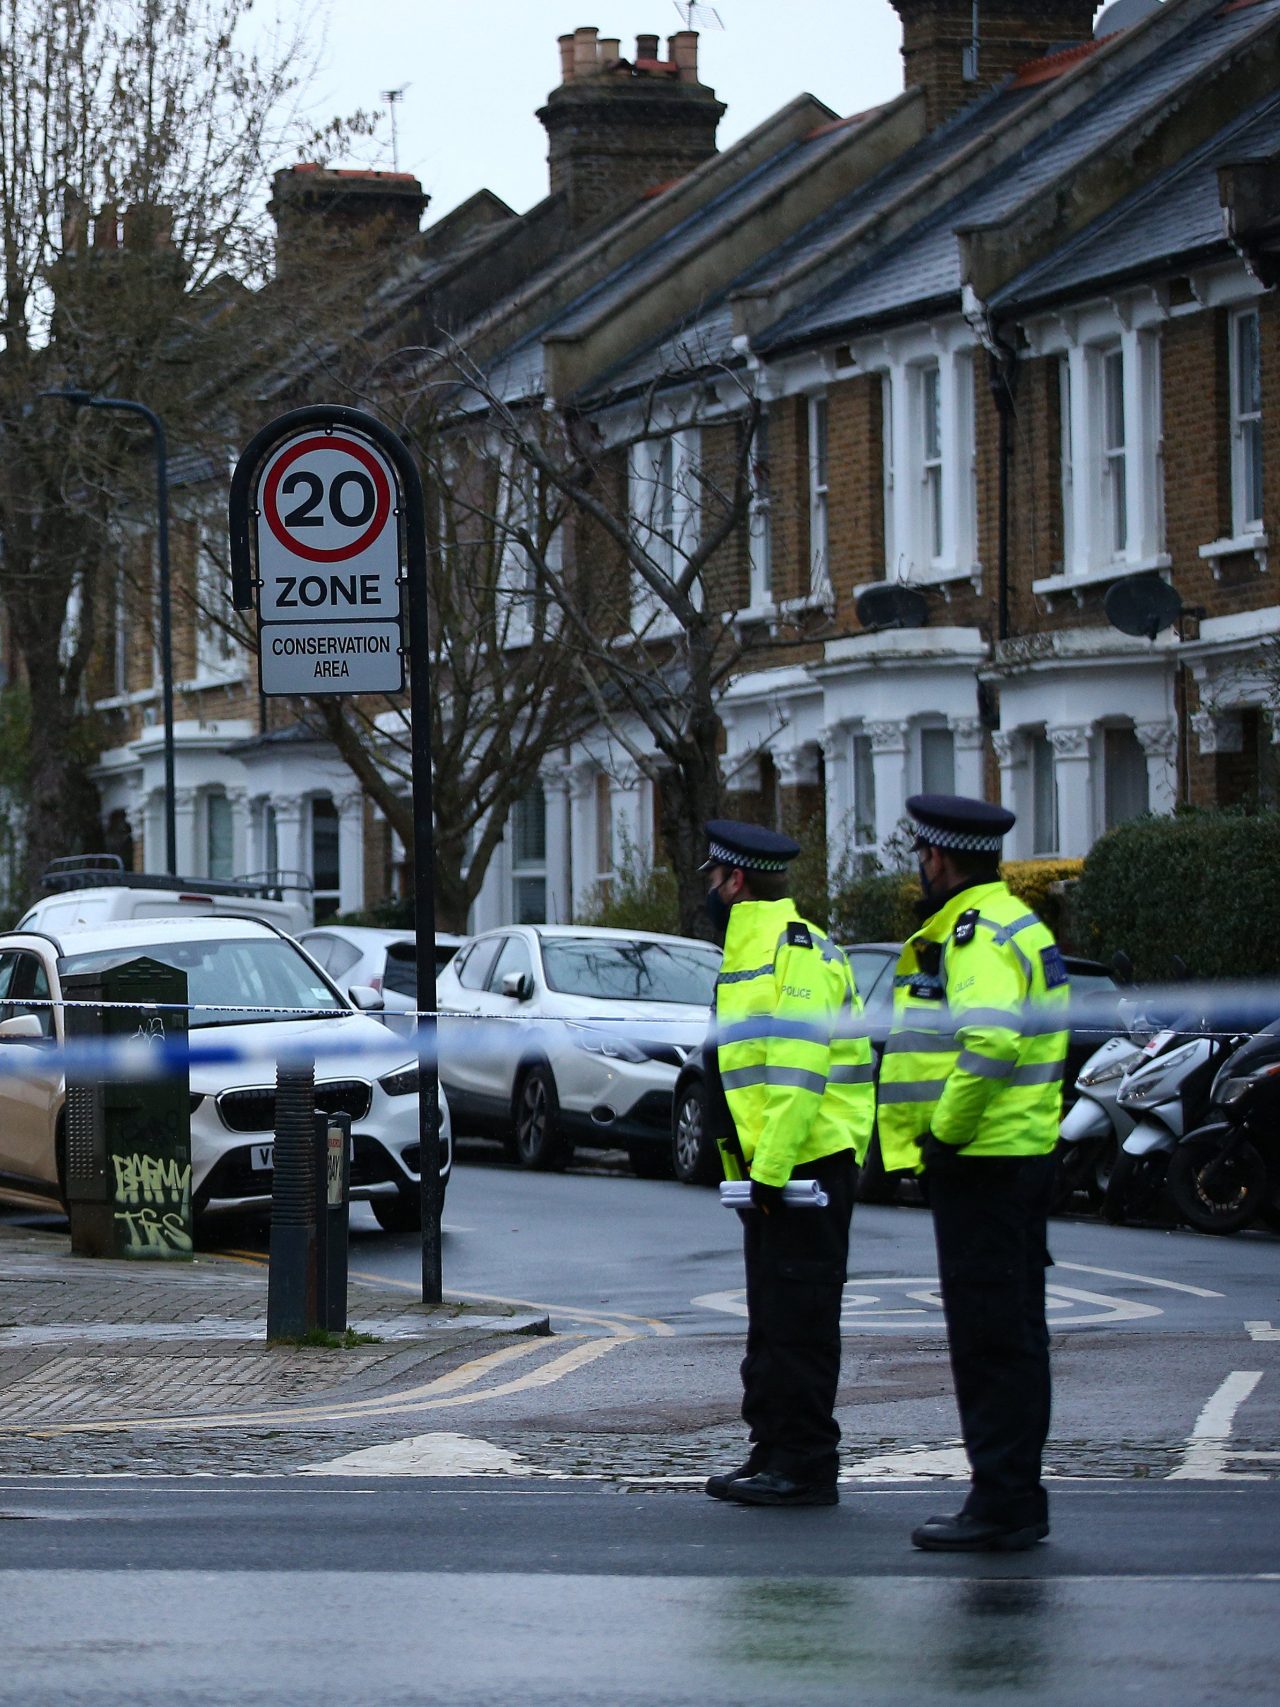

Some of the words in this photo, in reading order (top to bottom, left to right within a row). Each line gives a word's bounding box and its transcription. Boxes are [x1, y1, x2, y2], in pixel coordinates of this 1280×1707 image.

[282, 470, 376, 527] 20
[275, 575, 381, 607] ZONE
[272, 636, 390, 656] CONSERVATION
[314, 660, 349, 678] AREA
[782, 985, 812, 999] POLICE
